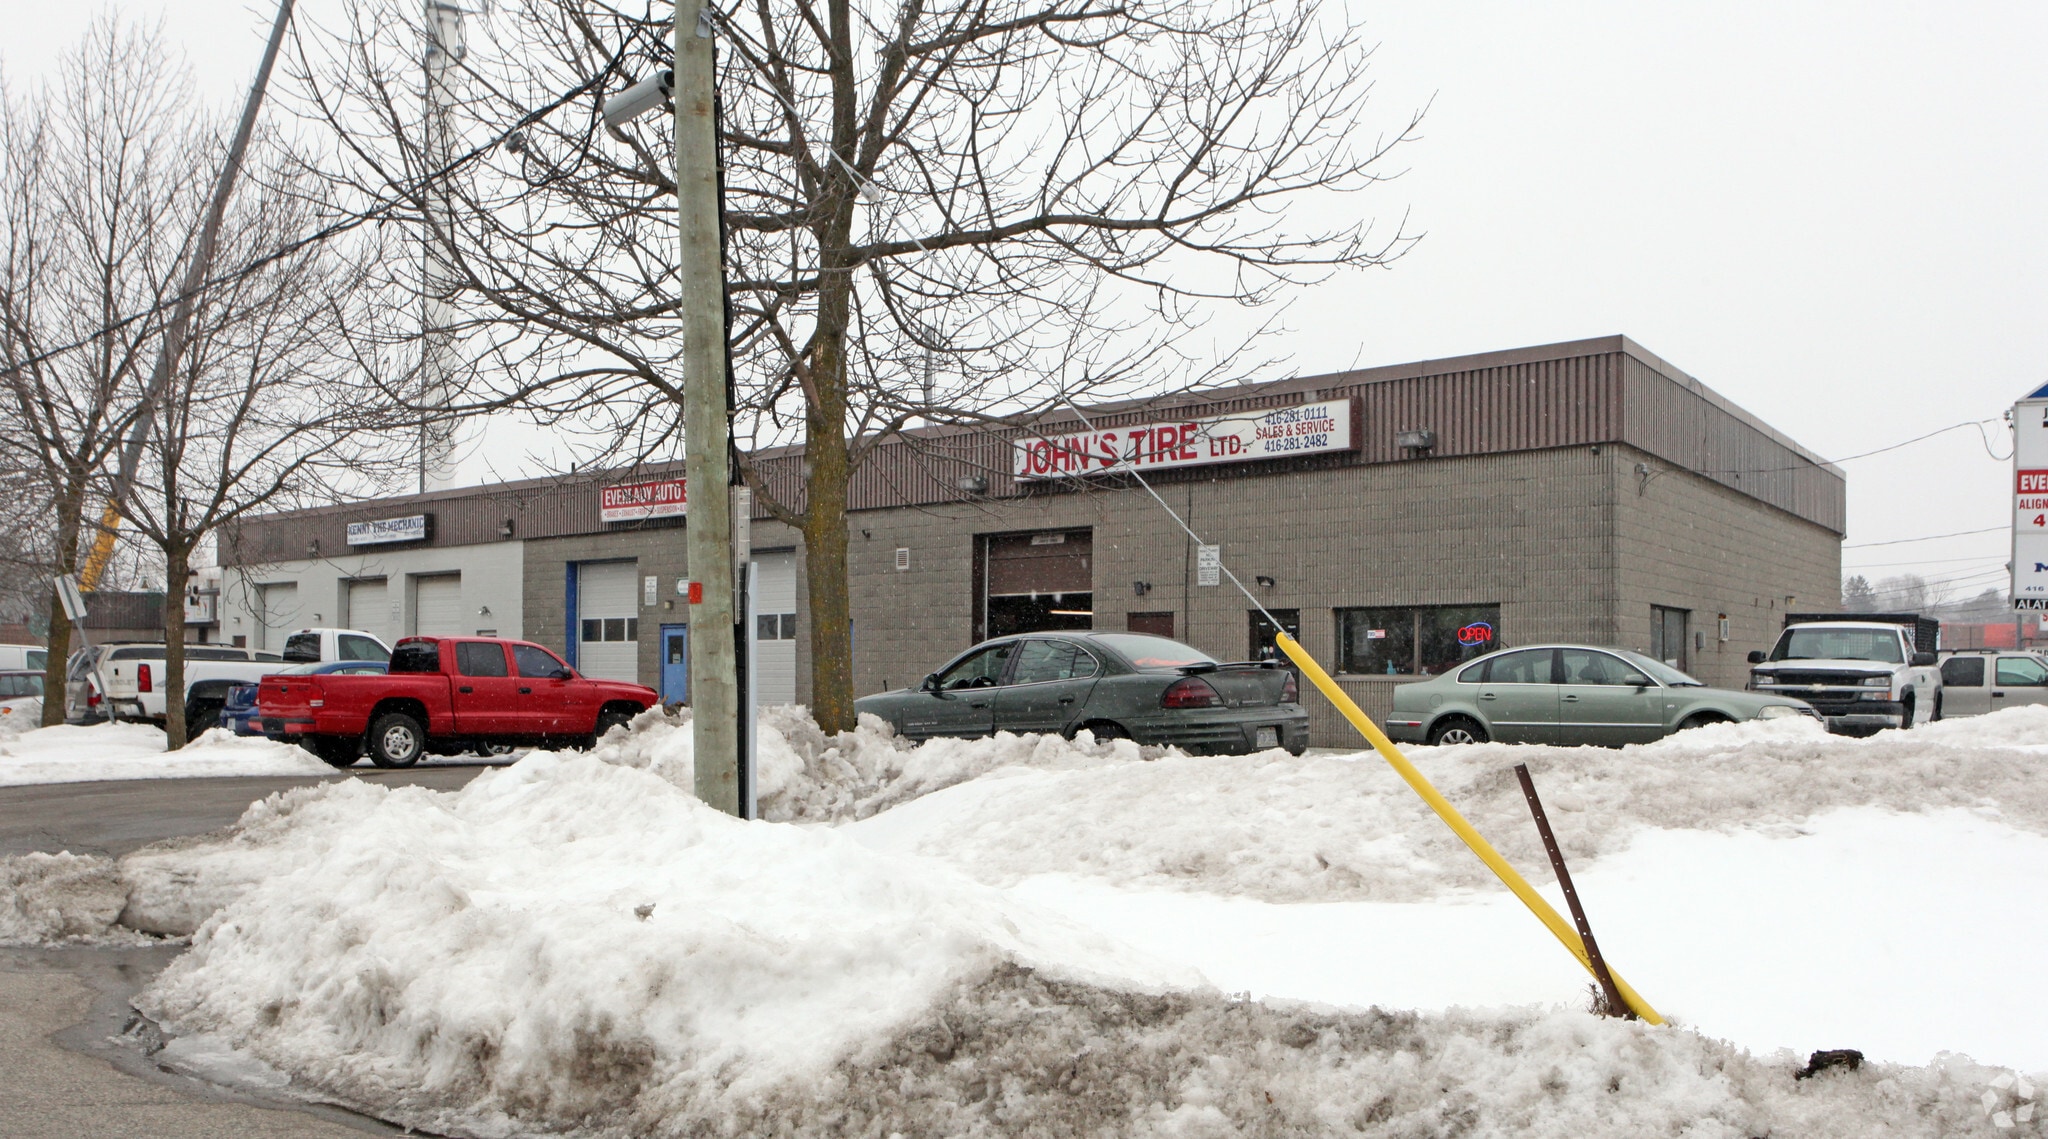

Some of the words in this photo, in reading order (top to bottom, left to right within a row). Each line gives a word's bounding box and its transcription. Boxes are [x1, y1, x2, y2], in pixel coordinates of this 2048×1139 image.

[1265, 406, 1328, 426] 416-281-0111
[1255, 425, 1284, 440] SALES
[1286, 424, 1293, 437] &
[1295, 418, 1335, 436] SERVICE
[1021, 432, 1119, 478] JOHN'S
[1128, 422, 1198, 466] TIRE
[1209, 433, 1247, 457] LTD.
[1264, 433, 1328, 453] 416-281-2482
[655, 482, 681, 502] AUTO
[2021, 474, 2048, 491] EVE
[348, 522, 370, 536] KENNY
[373, 521, 387, 534] THE
[388, 516, 425, 532] MECHANIC
[2033, 513, 2046, 527] 4
[1457, 627, 1491, 641] OPEN
